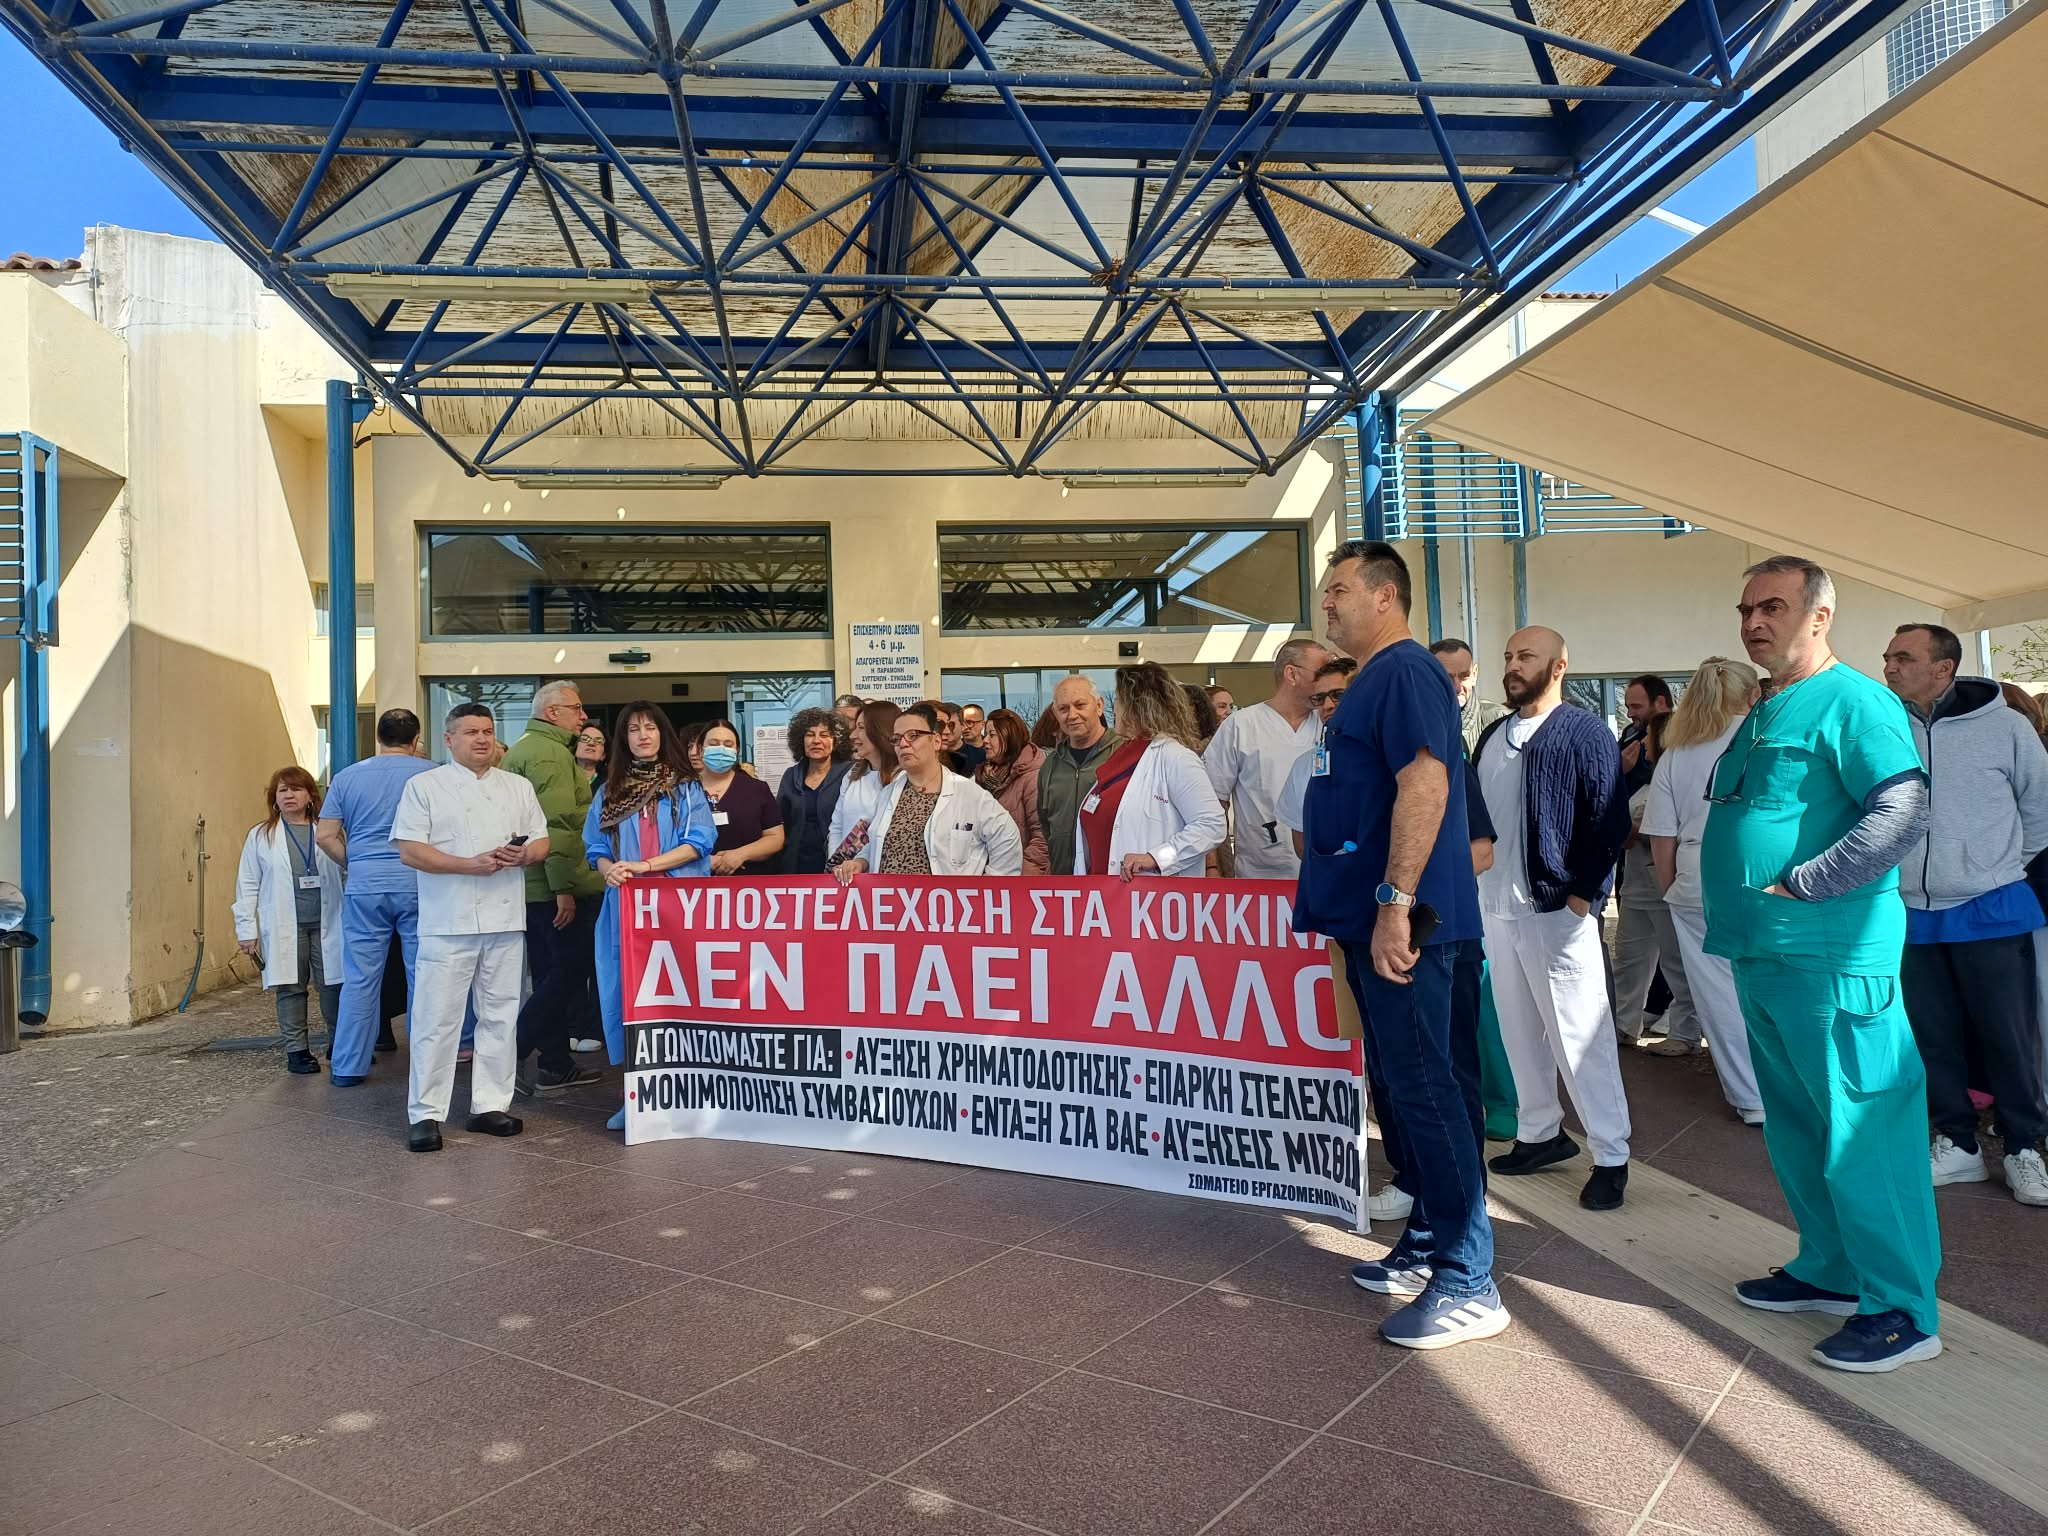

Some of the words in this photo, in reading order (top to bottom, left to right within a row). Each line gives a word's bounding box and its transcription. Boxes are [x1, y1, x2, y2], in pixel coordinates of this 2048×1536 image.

[854, 625, 891, 635] ΕΠΙΣΚΕΠΤΗΡΙΟ
[869, 640, 874, 649] 4
[881, 640, 886, 649] 6
[890, 641, 905, 652] μ.μ.
[896, 656, 919, 665] ΑΥΣΤΗΡΑ
[634, 888, 660, 930] Η
[676, 887, 1012, 935] ΥΠΟΣΤΕΛΕΧΩΣΗ
[1029, 889, 1113, 938] ΣΤΑ
[1131, 891, 1335, 950] ΚΟΚΚΙΝ
[633, 940, 805, 1012] ΔΕΝ
[848, 942, 1049, 1025] ΠΑΕΙ
[634, 1028, 787, 1072] ΑΓΩΝΙΖΟΜΑΣΤΕ
[793, 1034, 834, 1072] ΓΙΑ:
[854, 1037, 931, 1080] ΑΥΞΗΣΗ
[937, 1041, 1132, 1100] ΧΡΗΜΑΤΟΔΟΤΗΣΗΣ
[1145, 1059, 1233, 1114] ΕΠΑΡΚΗ
[637, 1073, 798, 1116] ΜΟΝΙΜΟΠΟΙΗΣΗ
[802, 1082, 958, 1133] ΣΥΜΒΑΣΙΟΥΧΩΝ
[971, 1095, 1052, 1144] ΕΝΤΑΞΗ
[1059, 1104, 1099, 1149] ΣΤΑ
[1106, 1108, 1149, 1157] ΒΑΕ
[1163, 1117, 1280, 1171] ΑΥΞΗΣΕΙΣ
[1188, 1173, 1249, 1196] ΣΩΜΑΤΕΙΟ
[1251, 1180, 1340, 1209] ΕΡΓΑΖΟΜΕΝΩΝ
